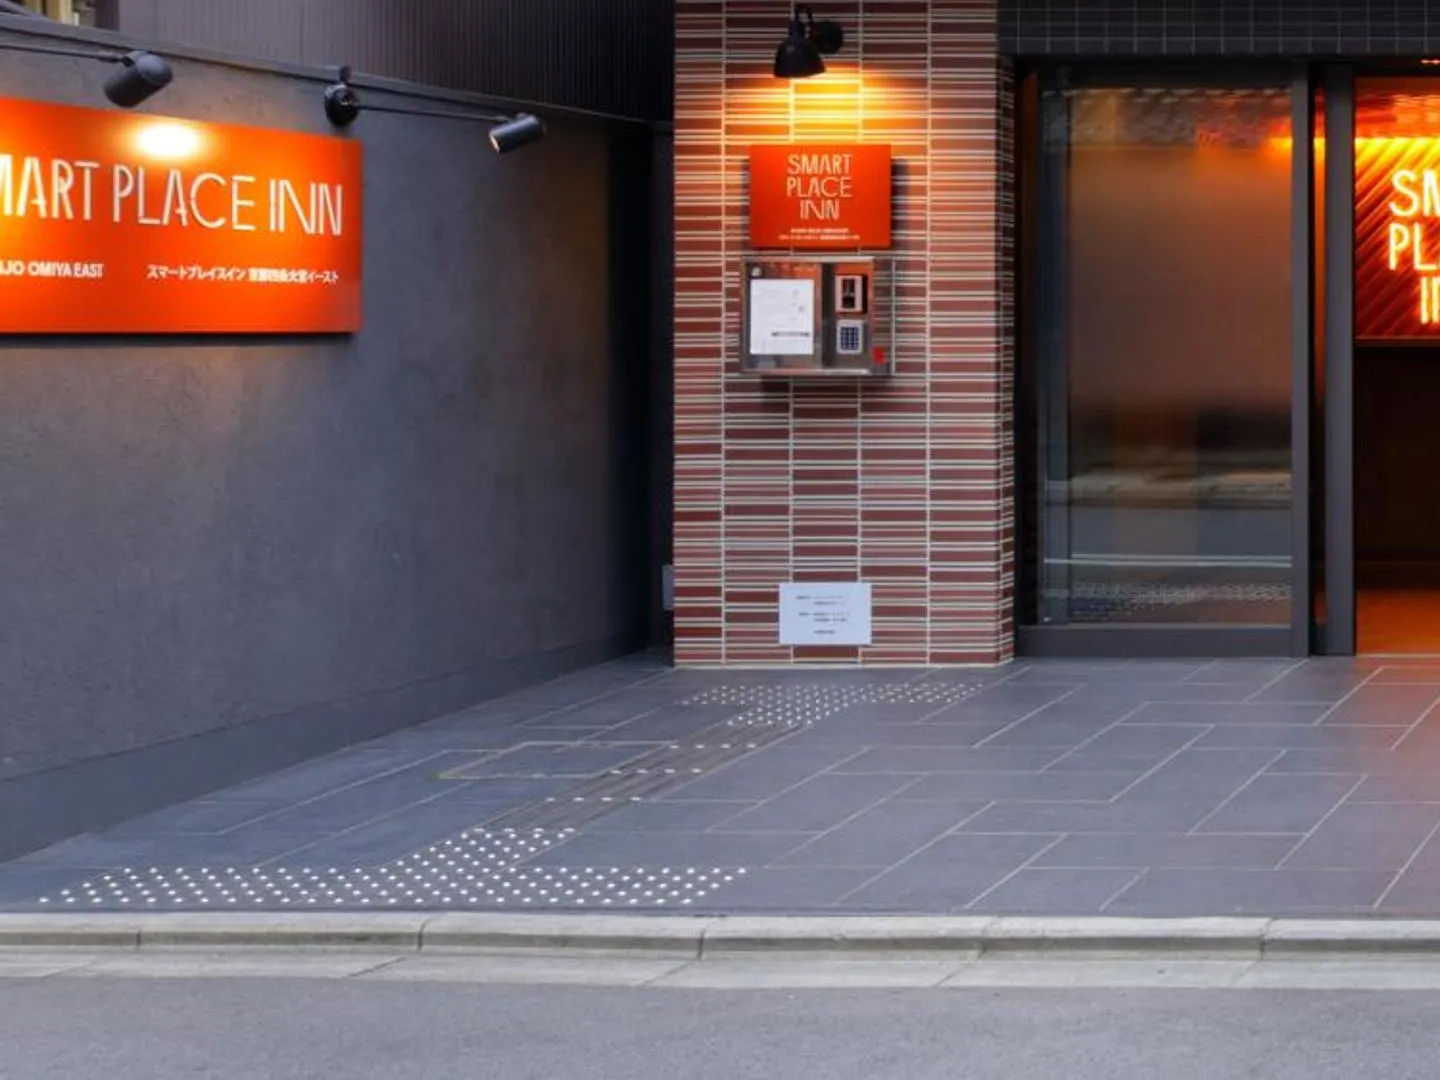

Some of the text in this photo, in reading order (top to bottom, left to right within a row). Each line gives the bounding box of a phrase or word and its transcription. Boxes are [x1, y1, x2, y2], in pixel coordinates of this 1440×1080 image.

[787, 153, 853, 175] SMART
[786, 176, 853, 198] PLACE
[112, 163, 256, 232] PLACE
[269, 178, 343, 236] INN
[800, 198, 840, 221] INN
[27, 260, 72, 278] OMIYA
[73, 261, 104, 279] EAST
